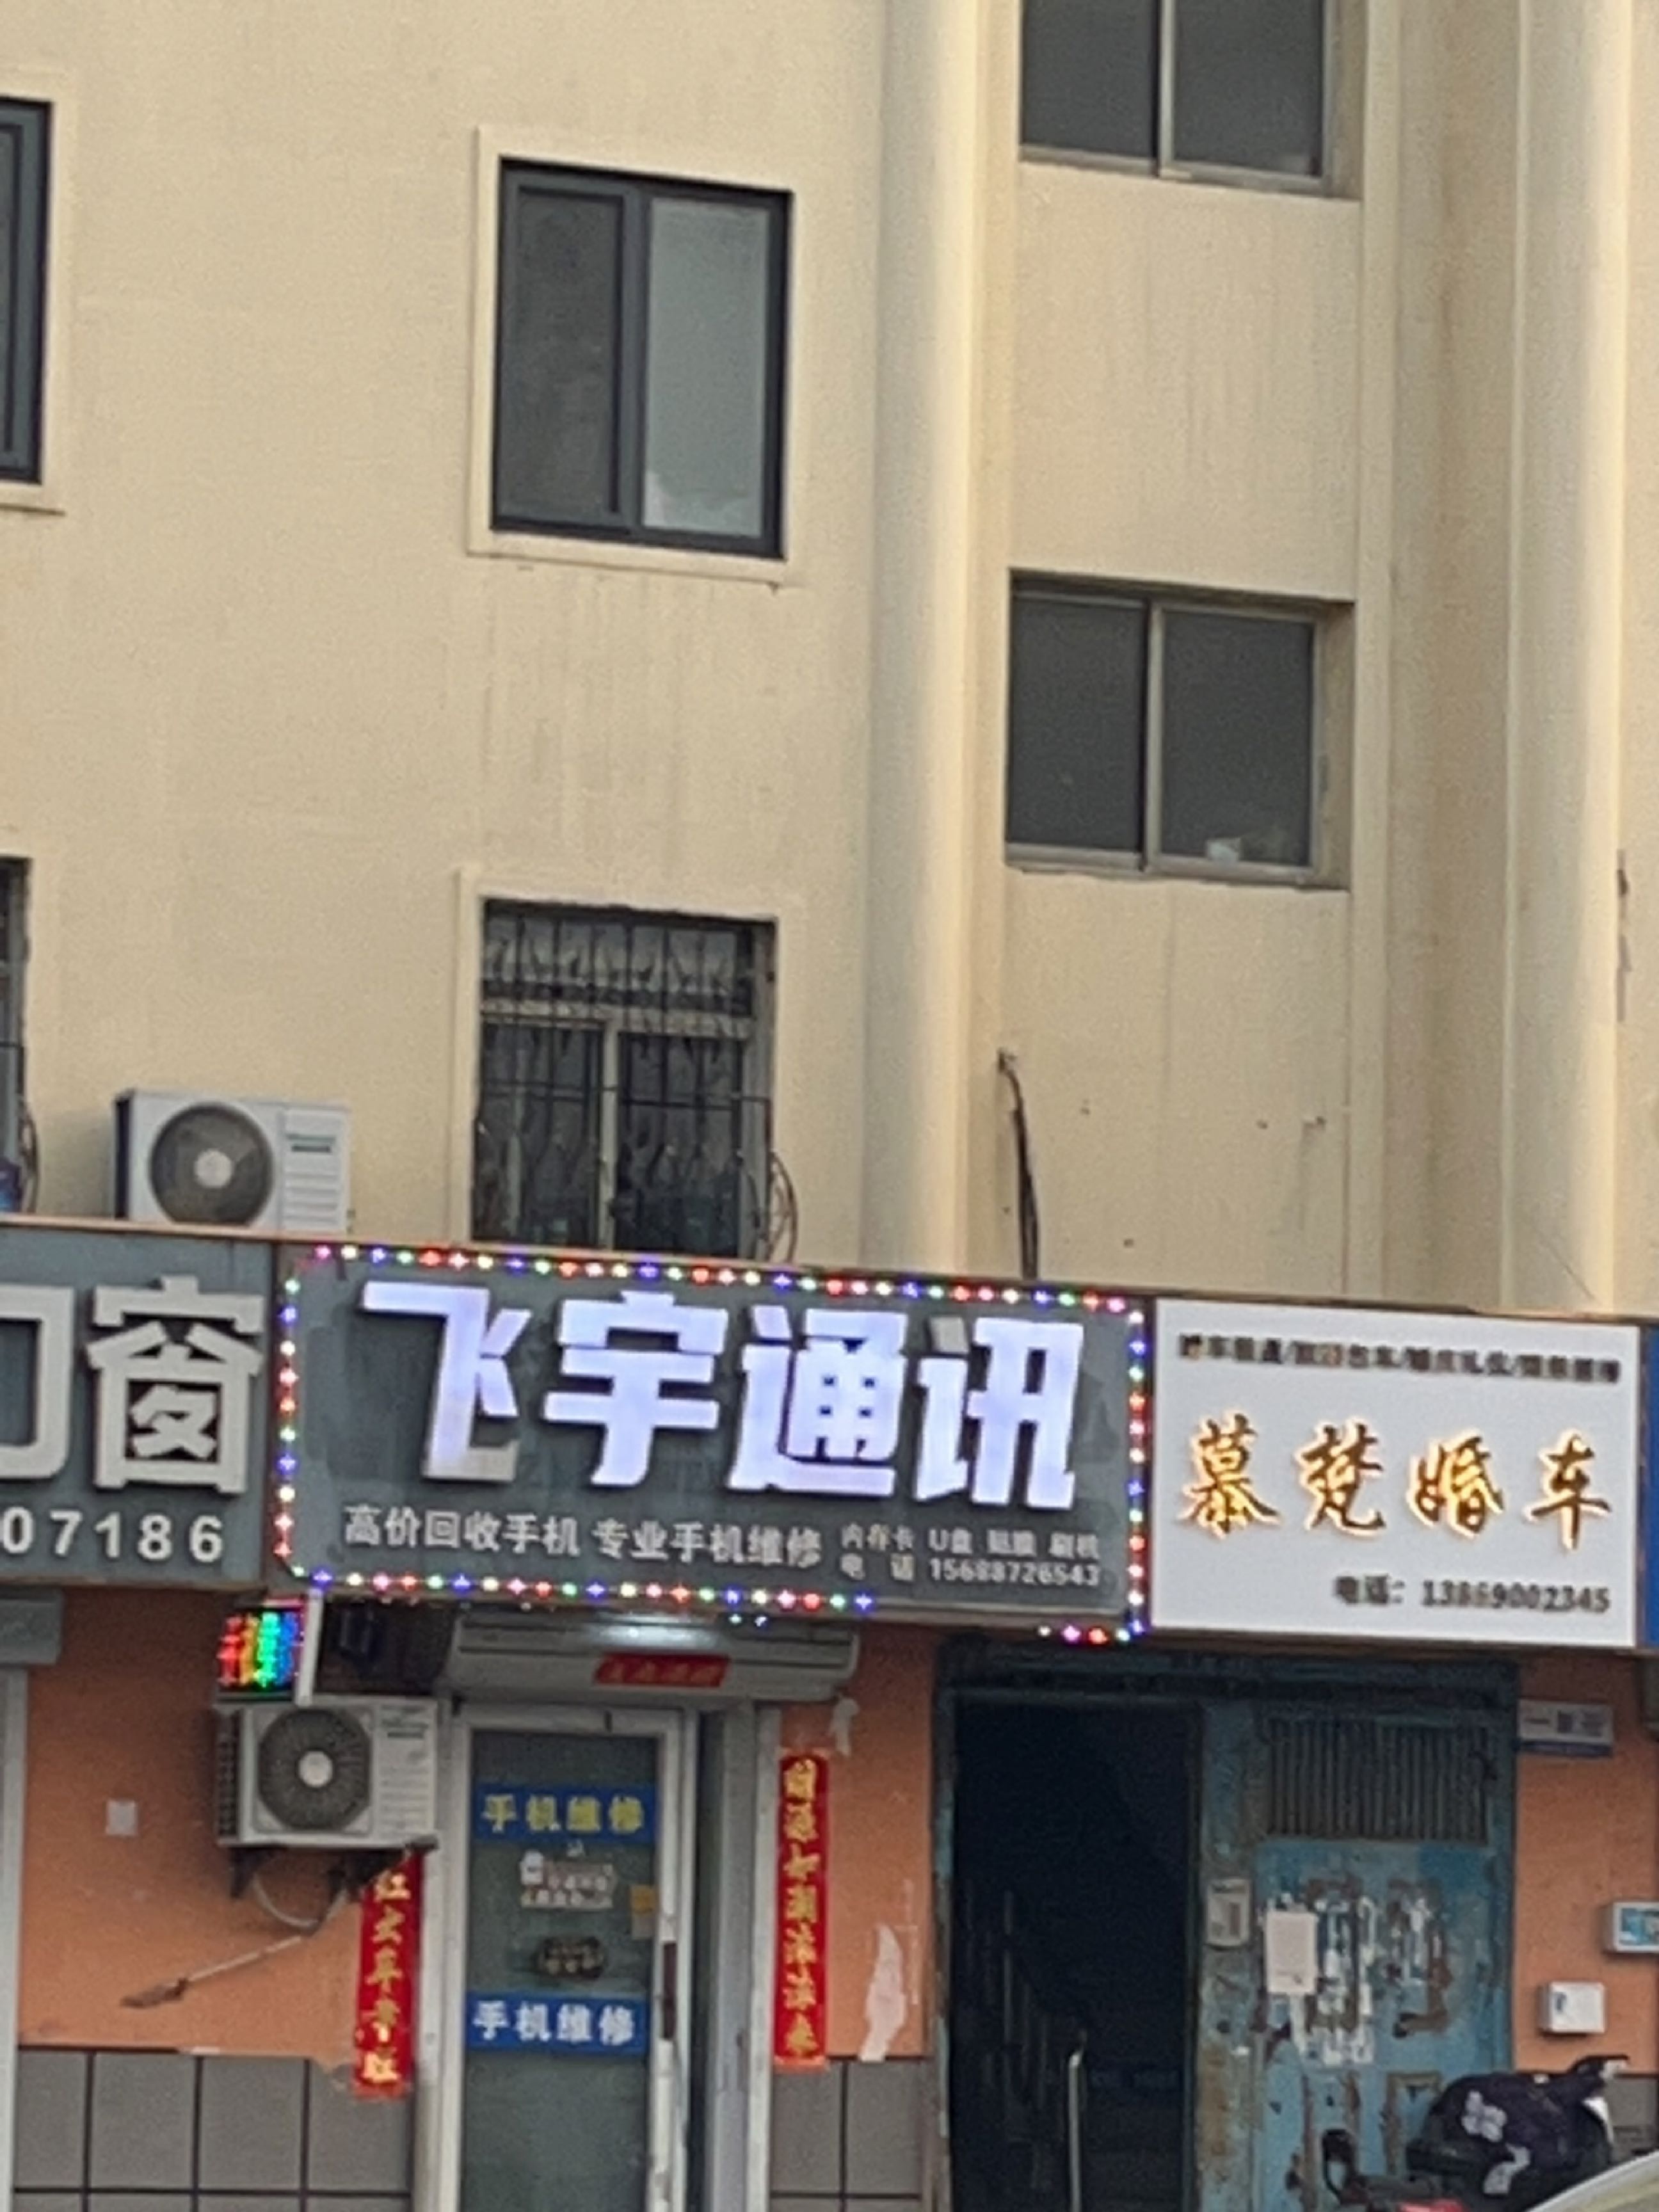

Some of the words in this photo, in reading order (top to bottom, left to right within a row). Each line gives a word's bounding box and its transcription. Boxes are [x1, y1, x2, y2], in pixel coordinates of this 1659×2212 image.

[361, 1279, 1085, 1509] 飞宇通讯
[344, 1505, 580, 1557] 高价回收手机
[592, 1518, 823, 1569] 专业手机维修
[482, 1793, 645, 1834] 手机维修
[473, 1999, 634, 2046] 手机维修
